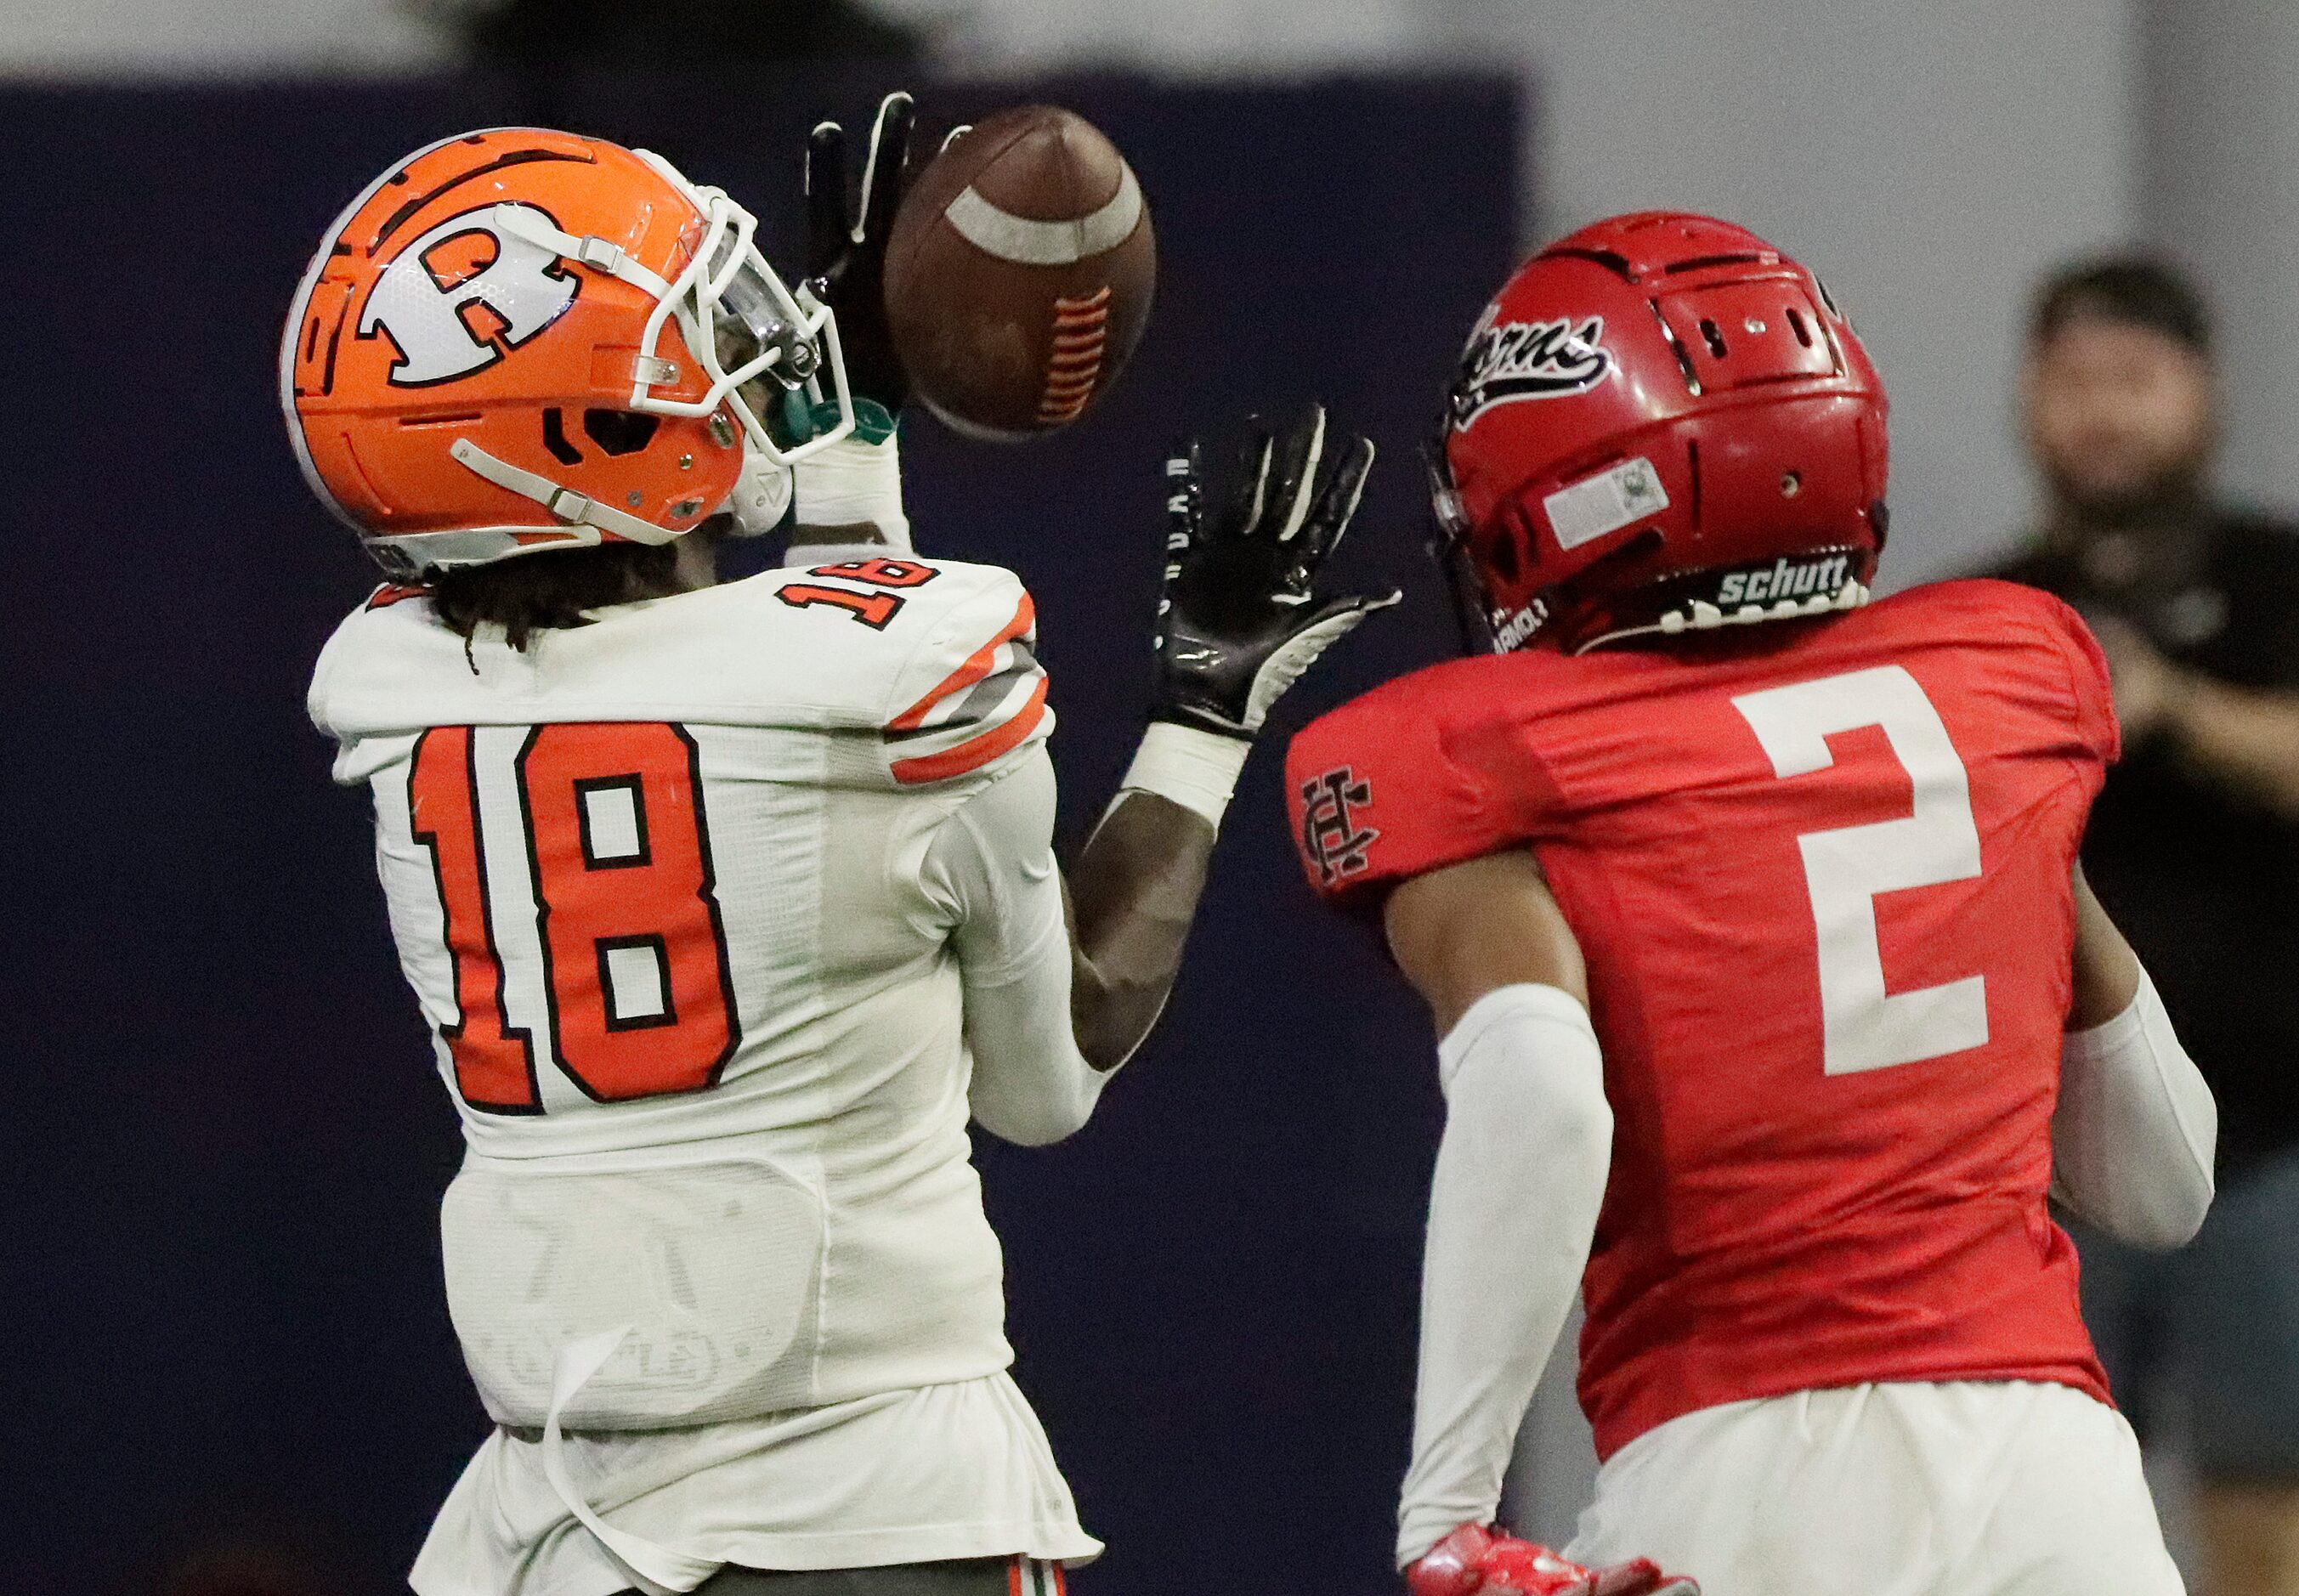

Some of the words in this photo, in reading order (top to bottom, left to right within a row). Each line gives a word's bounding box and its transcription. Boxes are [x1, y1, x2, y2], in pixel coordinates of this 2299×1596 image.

[354, 199, 583, 389] R
[773, 557, 943, 632] 18
[1717, 557, 1849, 604] schutt
[406, 721, 744, 1117] 18
[1730, 664, 1990, 1077] 2
